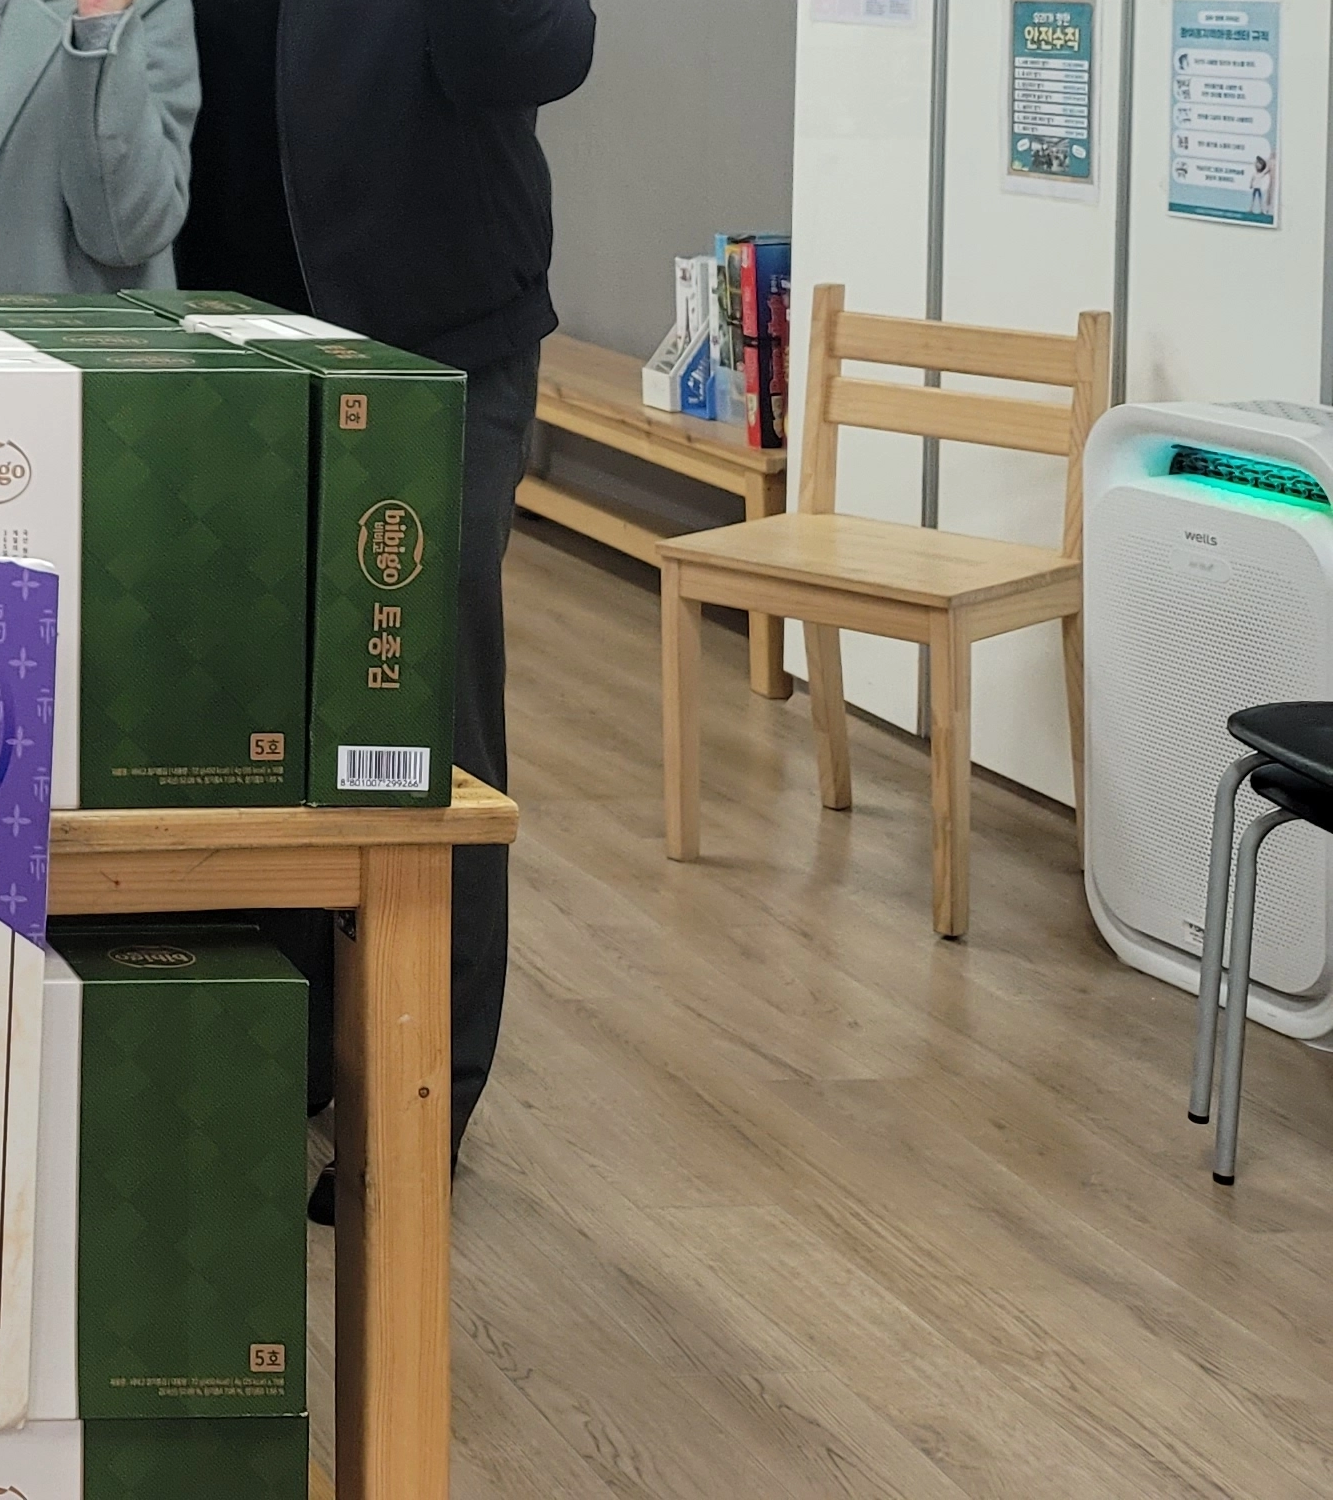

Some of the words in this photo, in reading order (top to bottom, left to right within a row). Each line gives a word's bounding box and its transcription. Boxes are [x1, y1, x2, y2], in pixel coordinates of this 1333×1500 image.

[1024, 25, 1080, 52] 안전수칙
[344, 399, 362, 426] 5호
[372, 521, 385, 554] 비비고
[376, 509, 406, 584] bibigo
[1184, 530, 1219, 547] wells
[367, 602, 401, 689] 토종김
[254, 739, 281, 756] 5호
[348, 778, 385, 788] 801007
[385, 778, 420, 788] 299266
[254, 1348, 282, 1368] 5호
